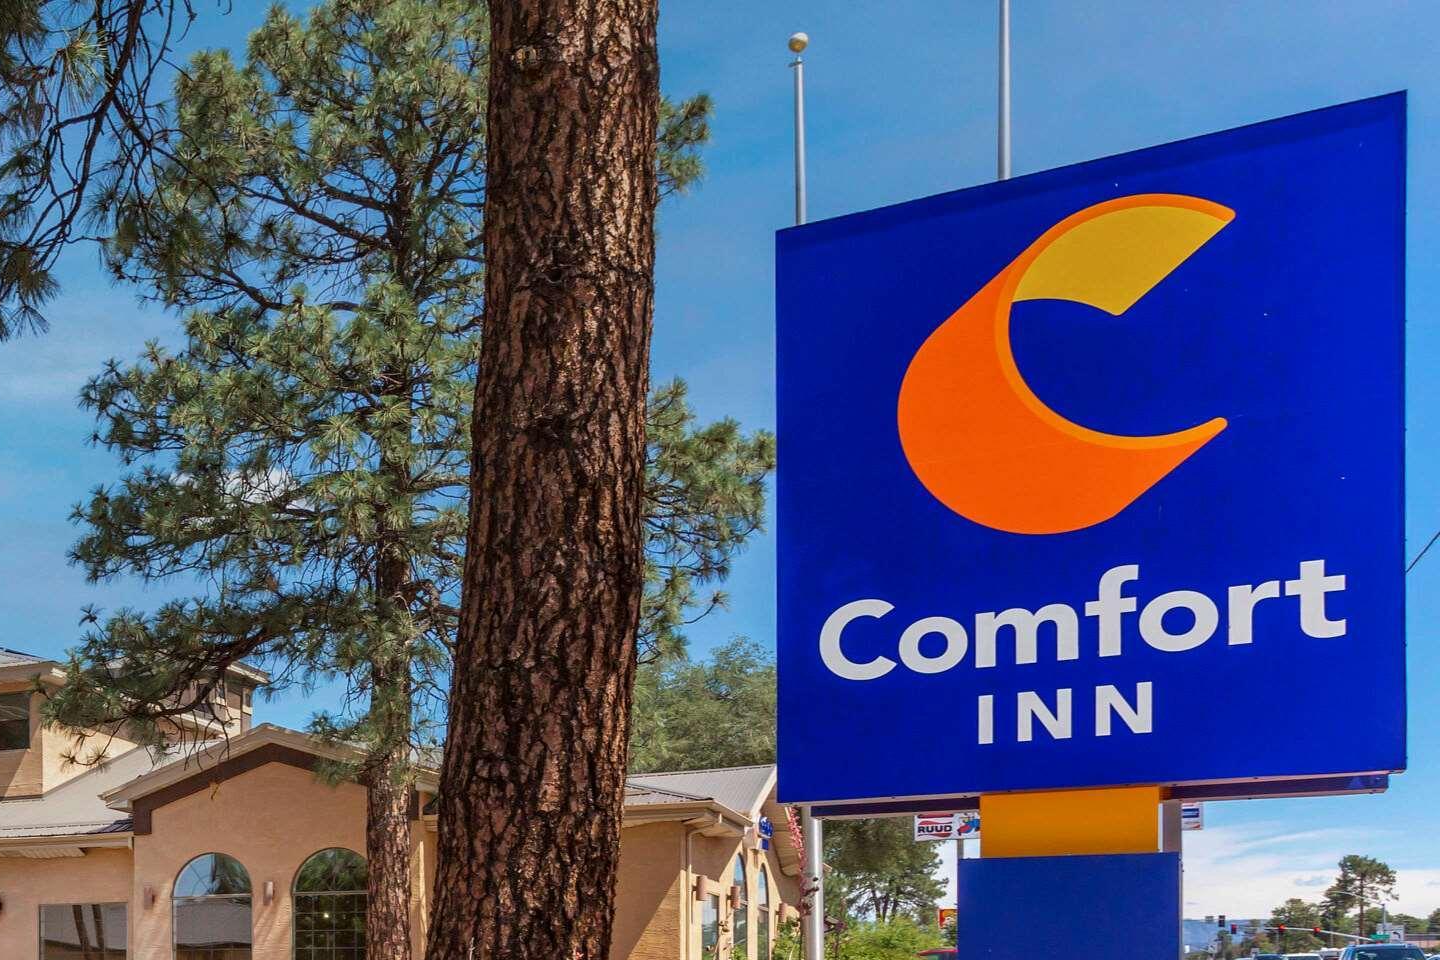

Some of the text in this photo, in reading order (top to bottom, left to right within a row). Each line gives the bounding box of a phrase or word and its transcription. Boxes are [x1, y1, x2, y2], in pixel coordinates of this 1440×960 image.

[819, 559, 1347, 681] Comfort
[977, 681, 1153, 745] INN
[918, 825, 953, 833] RUUD
